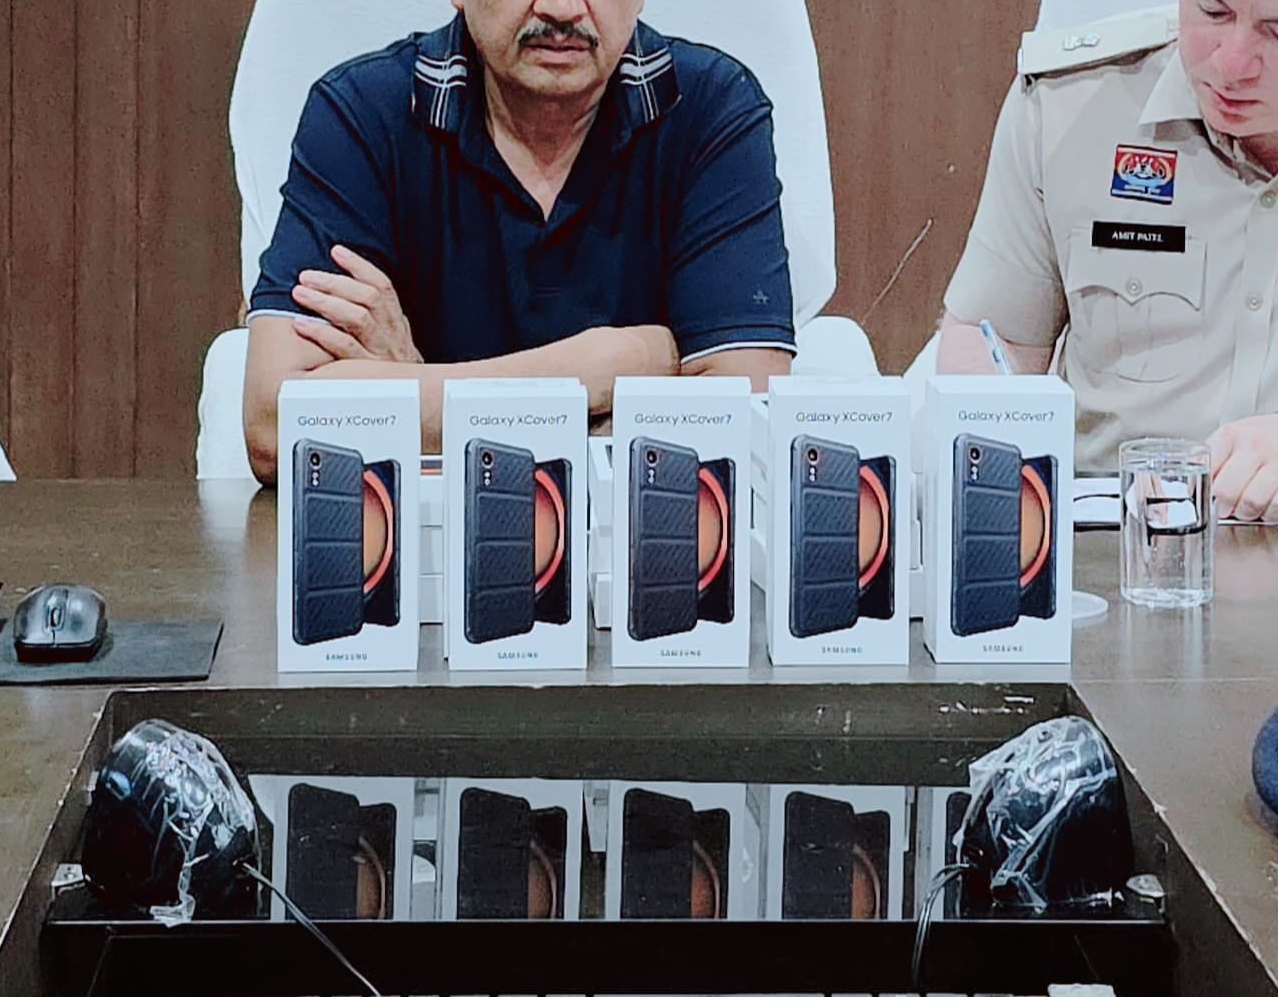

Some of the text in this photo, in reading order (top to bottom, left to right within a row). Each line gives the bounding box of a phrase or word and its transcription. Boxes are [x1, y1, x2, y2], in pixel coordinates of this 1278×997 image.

[1111, 230, 1135, 240] AMIT
[298, 415, 396, 427] Galaxy XCover7
[470, 414, 567, 427] Galaxy XCover7
[634, 413, 732, 426] Galaxy XCover7
[796, 412, 893, 424] Galaxy XCover7
[958, 411, 1055, 423] Galaxy XCover7
